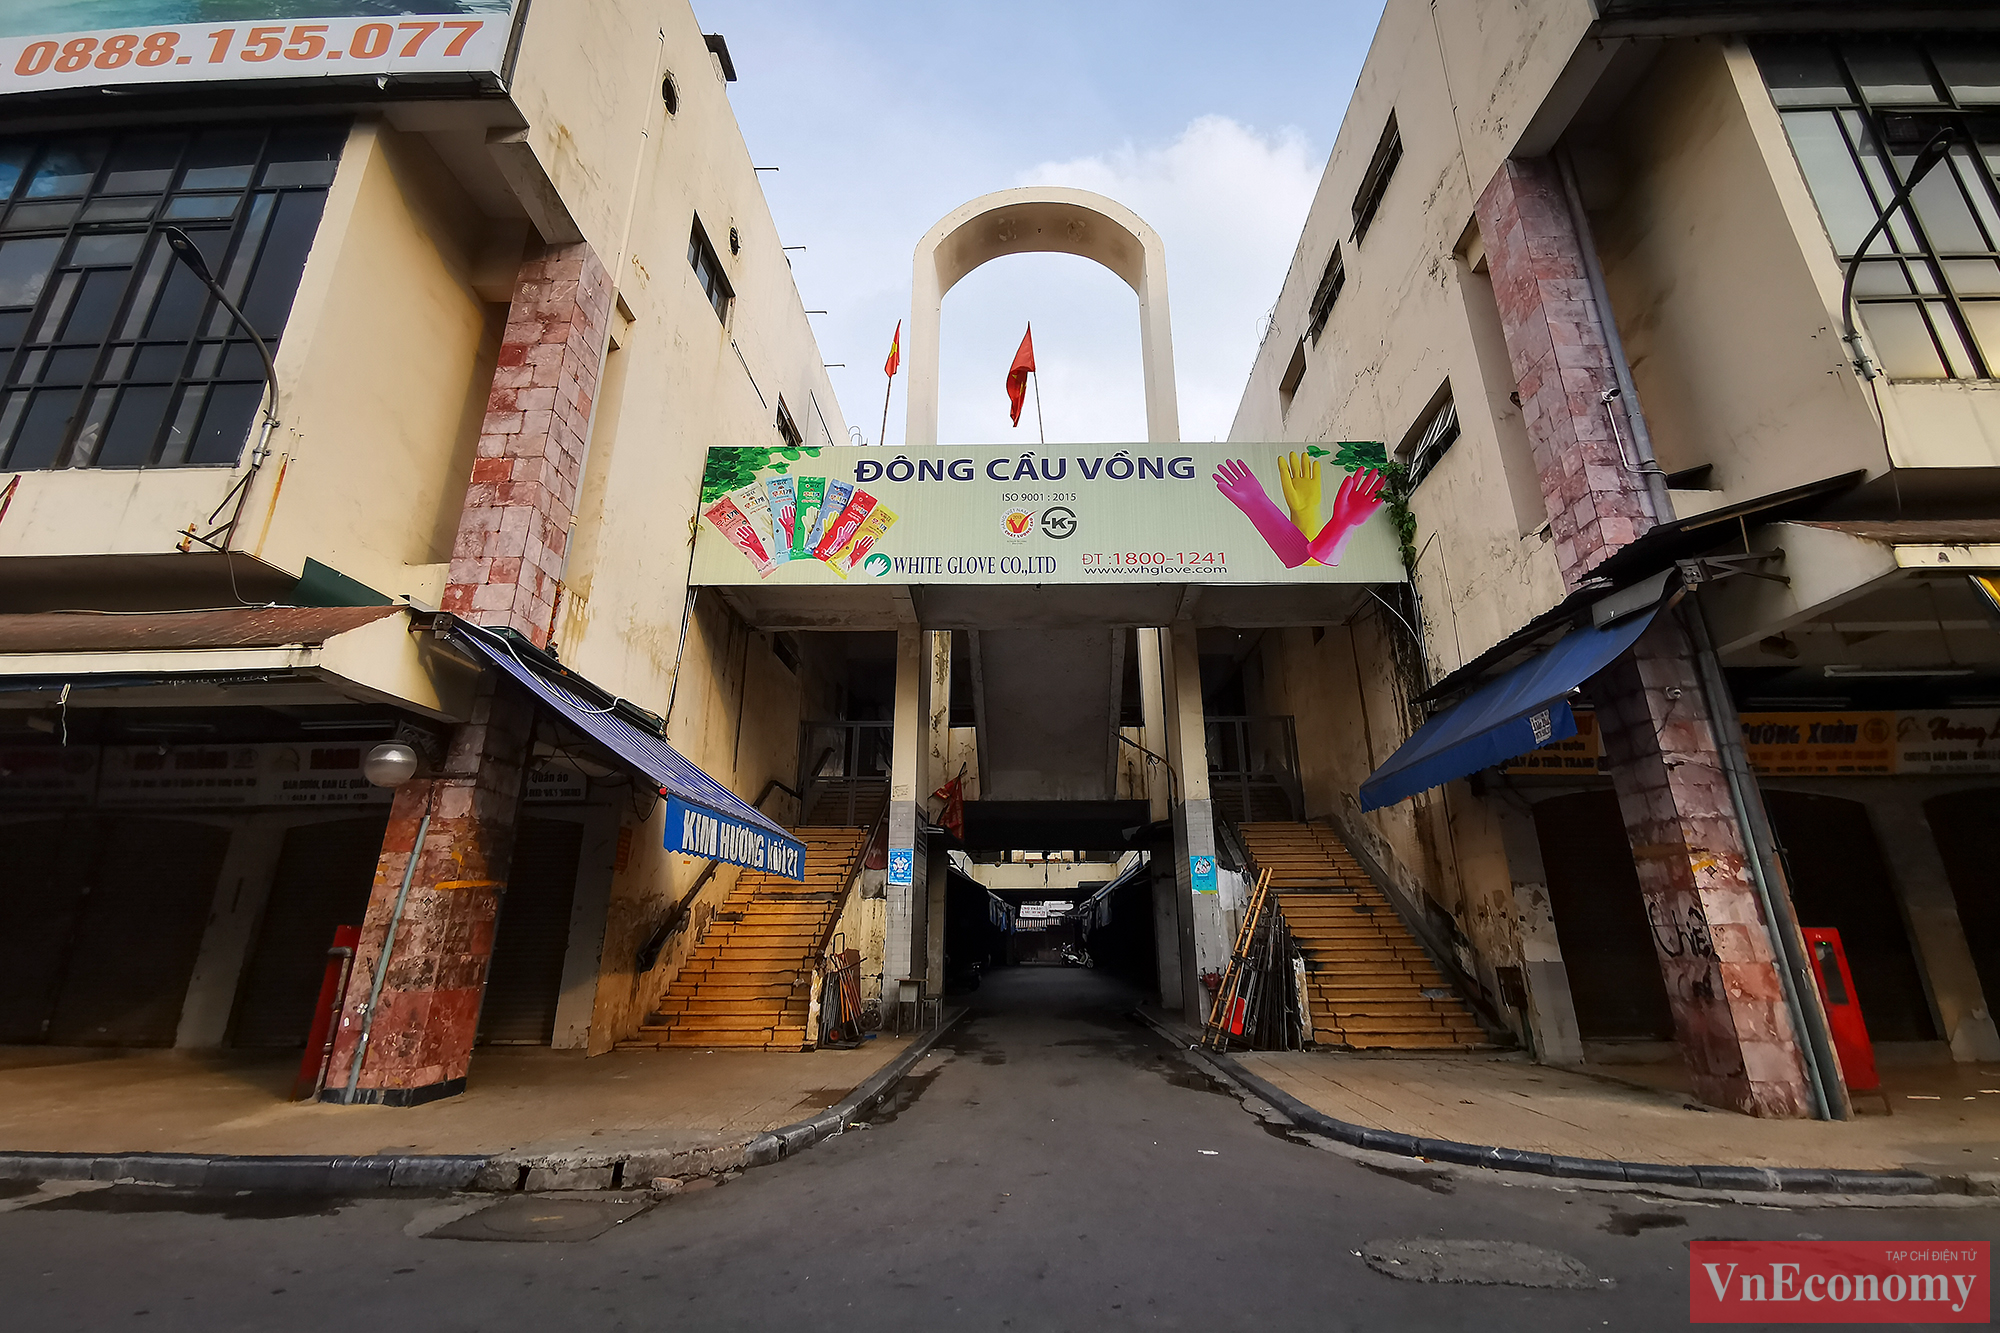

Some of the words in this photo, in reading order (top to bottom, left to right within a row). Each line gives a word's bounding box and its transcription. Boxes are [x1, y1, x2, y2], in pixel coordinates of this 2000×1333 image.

[14, 21, 484, 77] 0888.155.077
[853, 454, 975, 483] ĐÔNG
[986, 450, 1067, 482] CẦU
[1076, 449, 1196, 480] VỒNG
[1002, 493, 1019, 501] ISO
[1021, 493, 1044, 501] 9001
[1053, 493, 1077, 501] 2015
[893, 556, 943, 574] WHITE
[947, 556, 996, 574] GLOVE
[1082, 553, 1103, 565] ĐT
[1084, 565, 1228, 576] www.whglove.com
[681, 808, 718, 857] KIM
[719, 821, 765, 869] HƯƠNG
